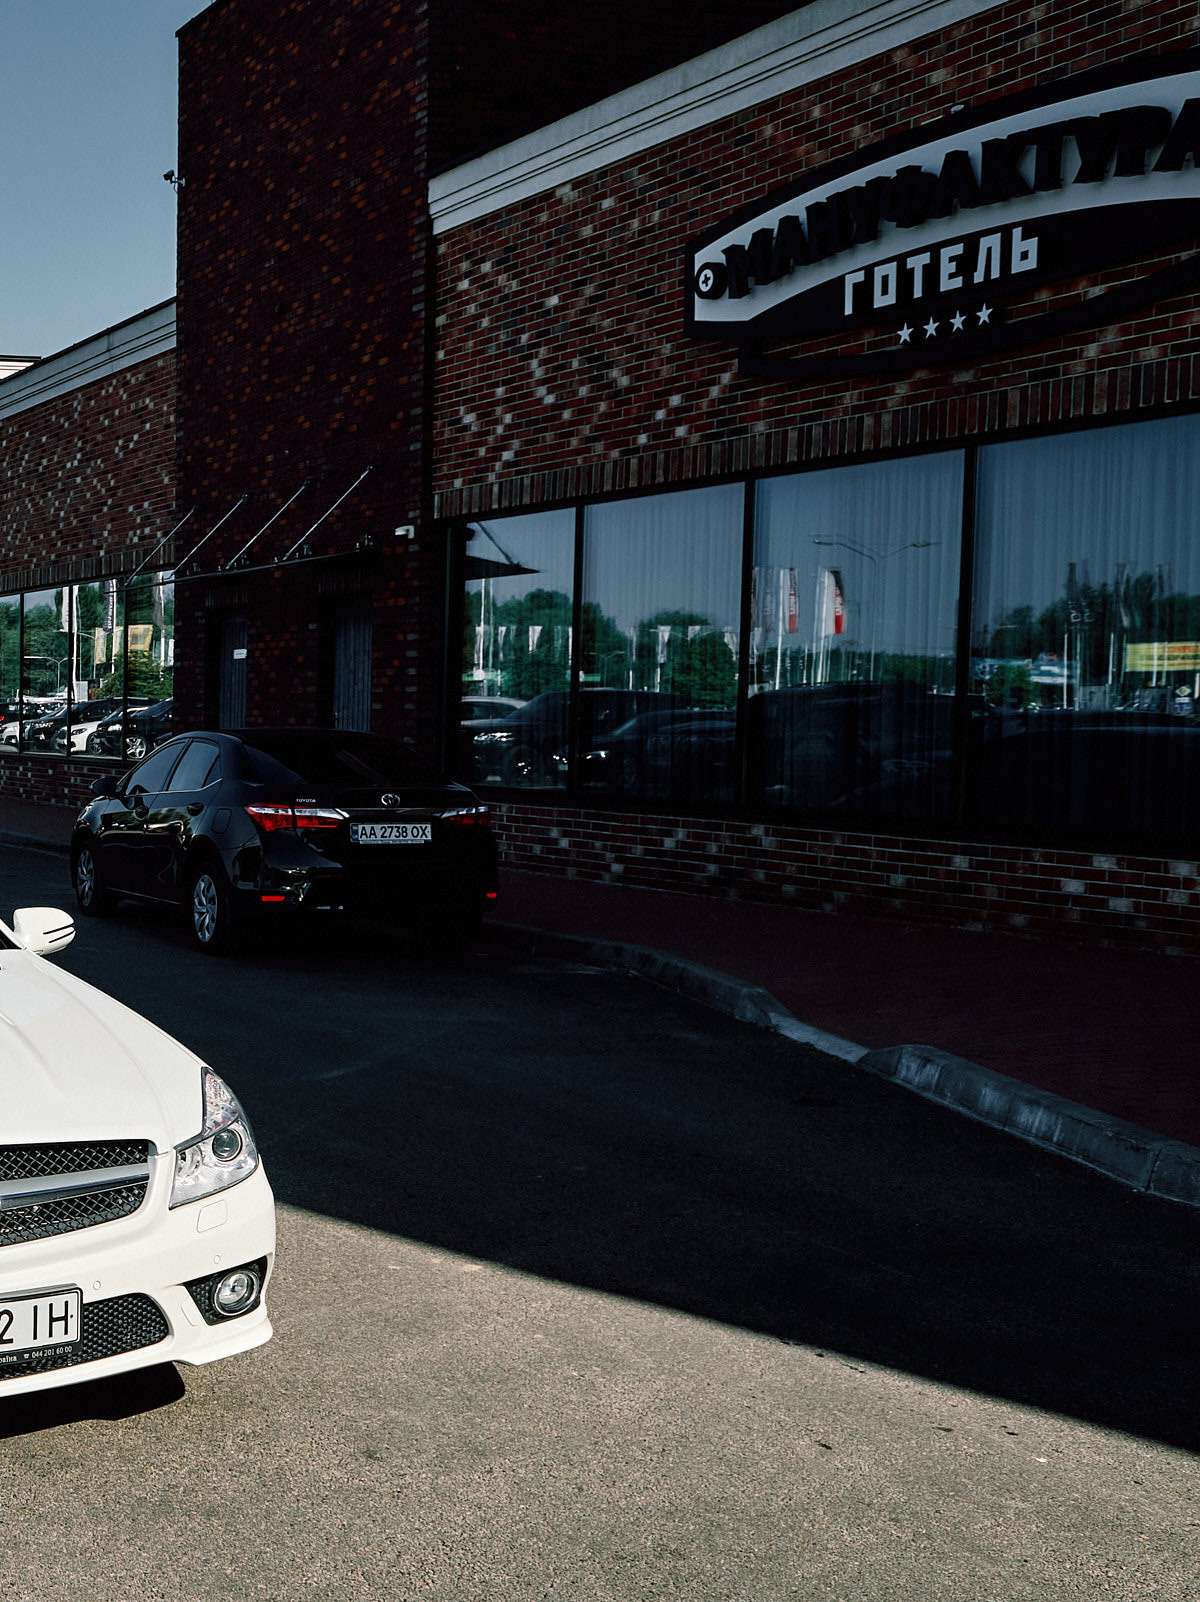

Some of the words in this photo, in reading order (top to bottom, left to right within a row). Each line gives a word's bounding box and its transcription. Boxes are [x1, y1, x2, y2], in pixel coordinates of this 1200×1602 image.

[721, 97, 1200, 300] МАНУФАКТУРА
[843, 226, 1039, 316] ГОТЕЛЬ
[359, 826, 377, 839] AA
[380, 826, 408, 839] 2738
[411, 826, 428, 839] OX
[32, 1300, 69, 1341] IH
[31, 1349, 43, 1359] 044
[43, 1348, 55, 1358] 201
[64, 1345, 73, 1354] 00
